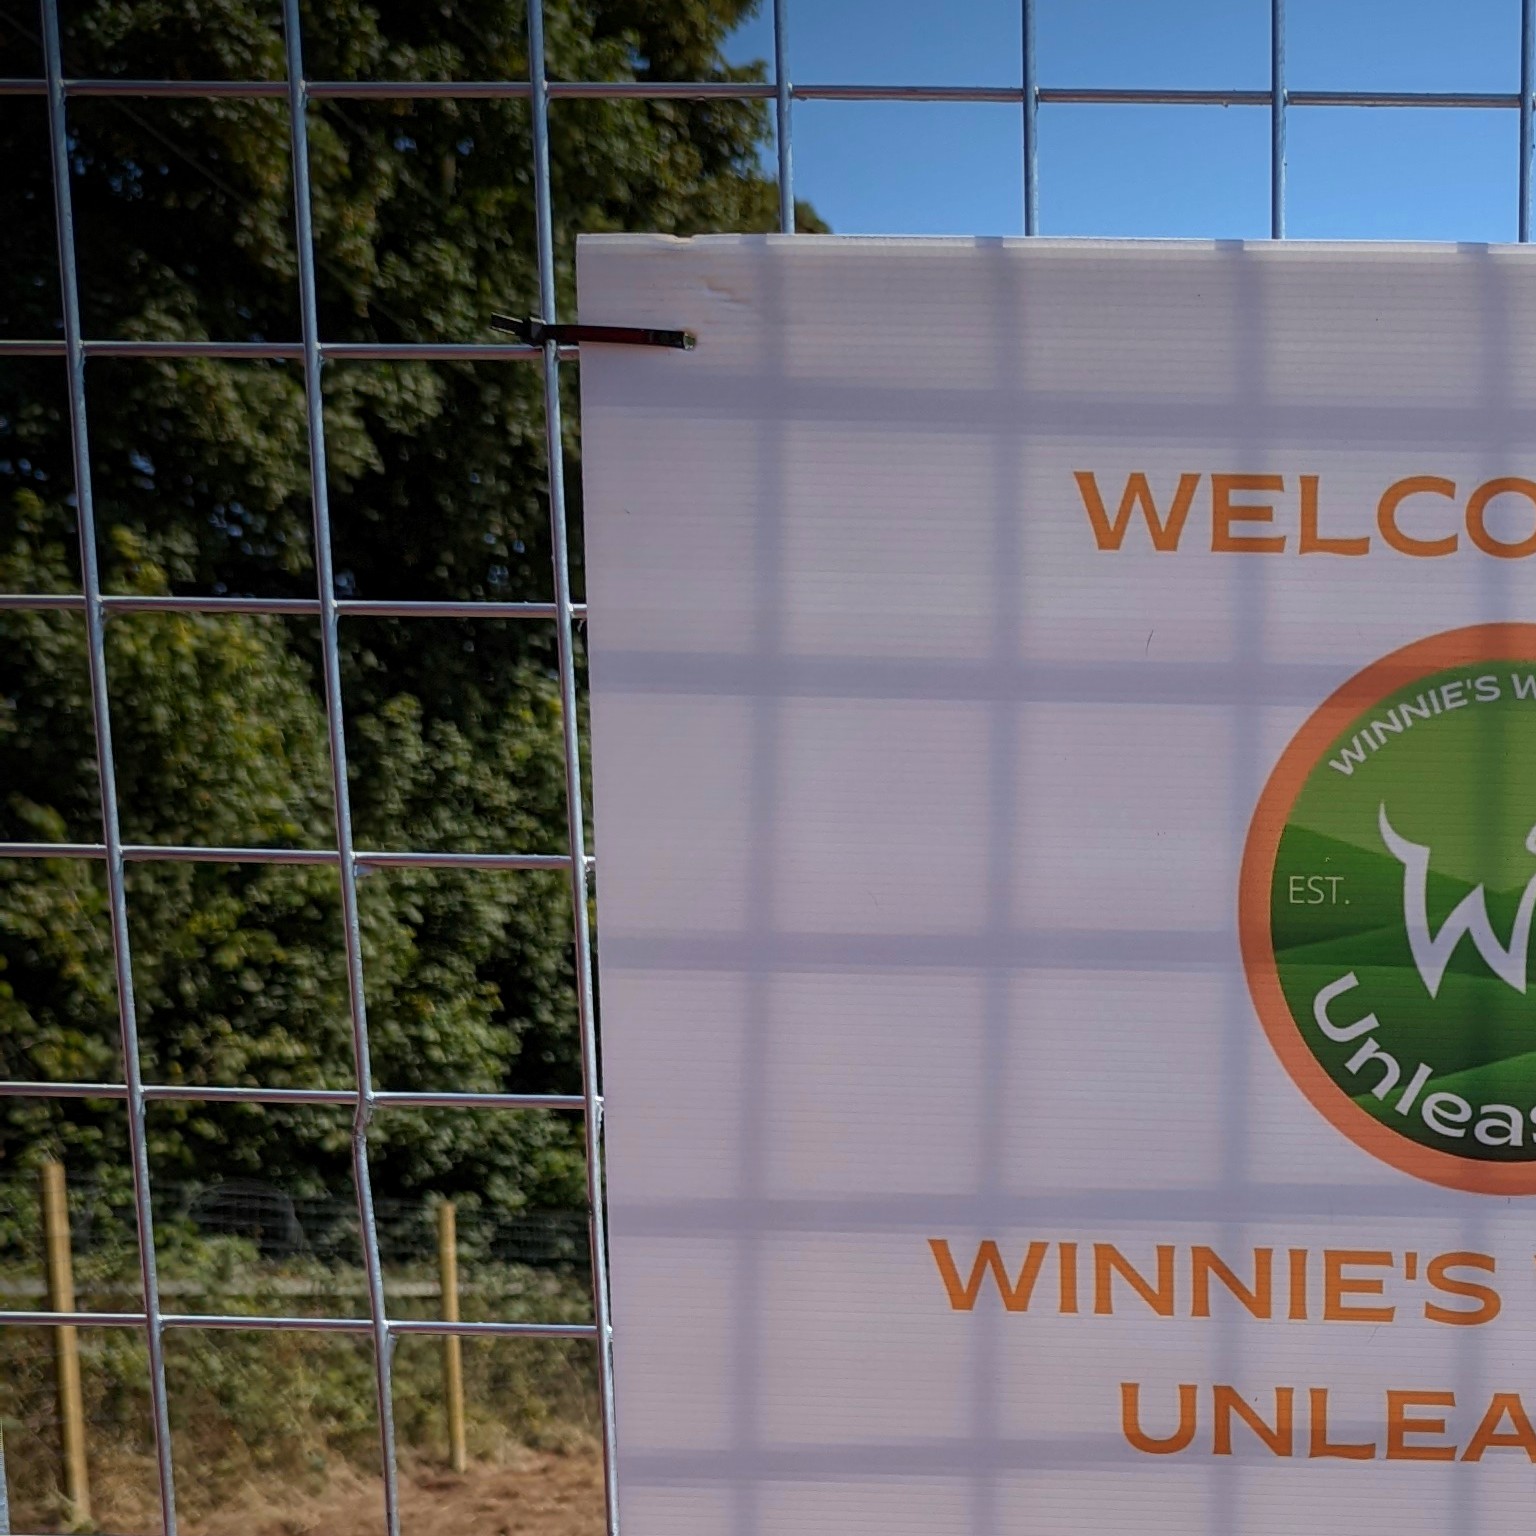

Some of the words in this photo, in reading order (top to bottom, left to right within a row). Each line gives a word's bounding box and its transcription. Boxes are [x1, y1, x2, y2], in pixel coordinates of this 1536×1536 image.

[1328, 674, 1502, 777] WINNIE'S
[1287, 875, 1351, 906] EST.
[926, 1236, 1503, 1328] WINNIE'S
